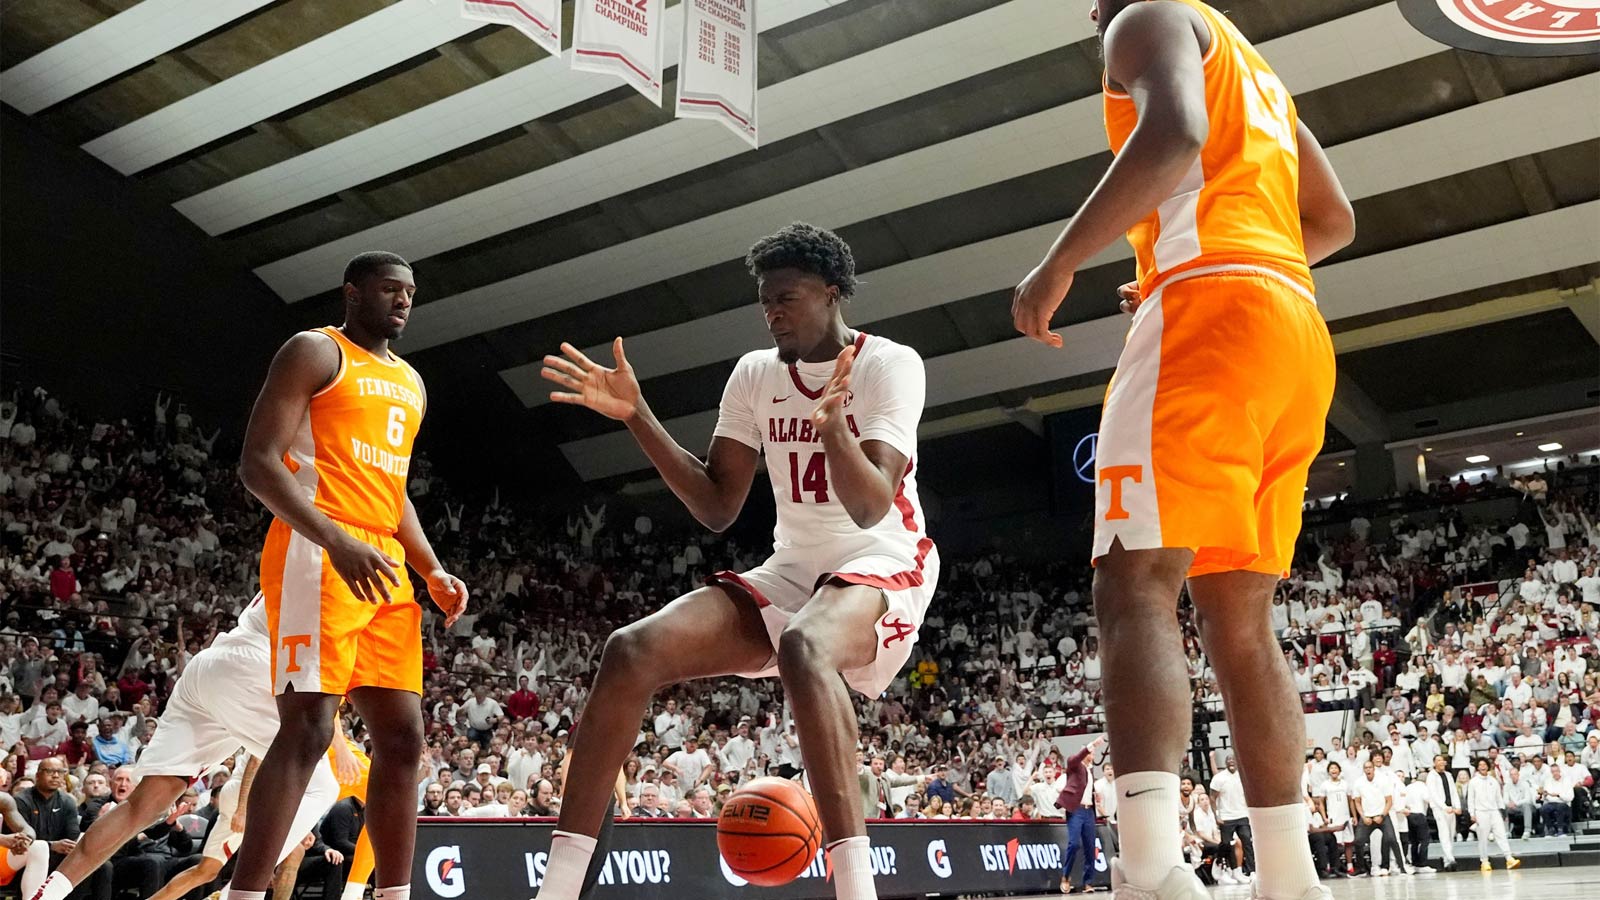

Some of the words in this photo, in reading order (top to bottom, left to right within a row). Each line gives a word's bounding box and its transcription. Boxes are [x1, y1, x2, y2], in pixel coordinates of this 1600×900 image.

[595, 3, 648, 37] CHAMPIONS
[708, 6, 746, 30] CHAMPIONS
[386, 406, 406, 447] 6
[769, 414, 860, 443] ALABA
[789, 452, 829, 503] 14
[1099, 465, 1142, 520] T
[282, 635, 311, 673] T
[723, 804, 770, 821] ELITE
[425, 845, 466, 899] G
[612, 849, 670, 884] YOU?
[869, 846, 897, 876] OU?
[927, 839, 952, 878] G
[980, 844, 998, 871] IS
[993, 844, 1010, 870] IT
[1026, 843, 1062, 870] YOU?
